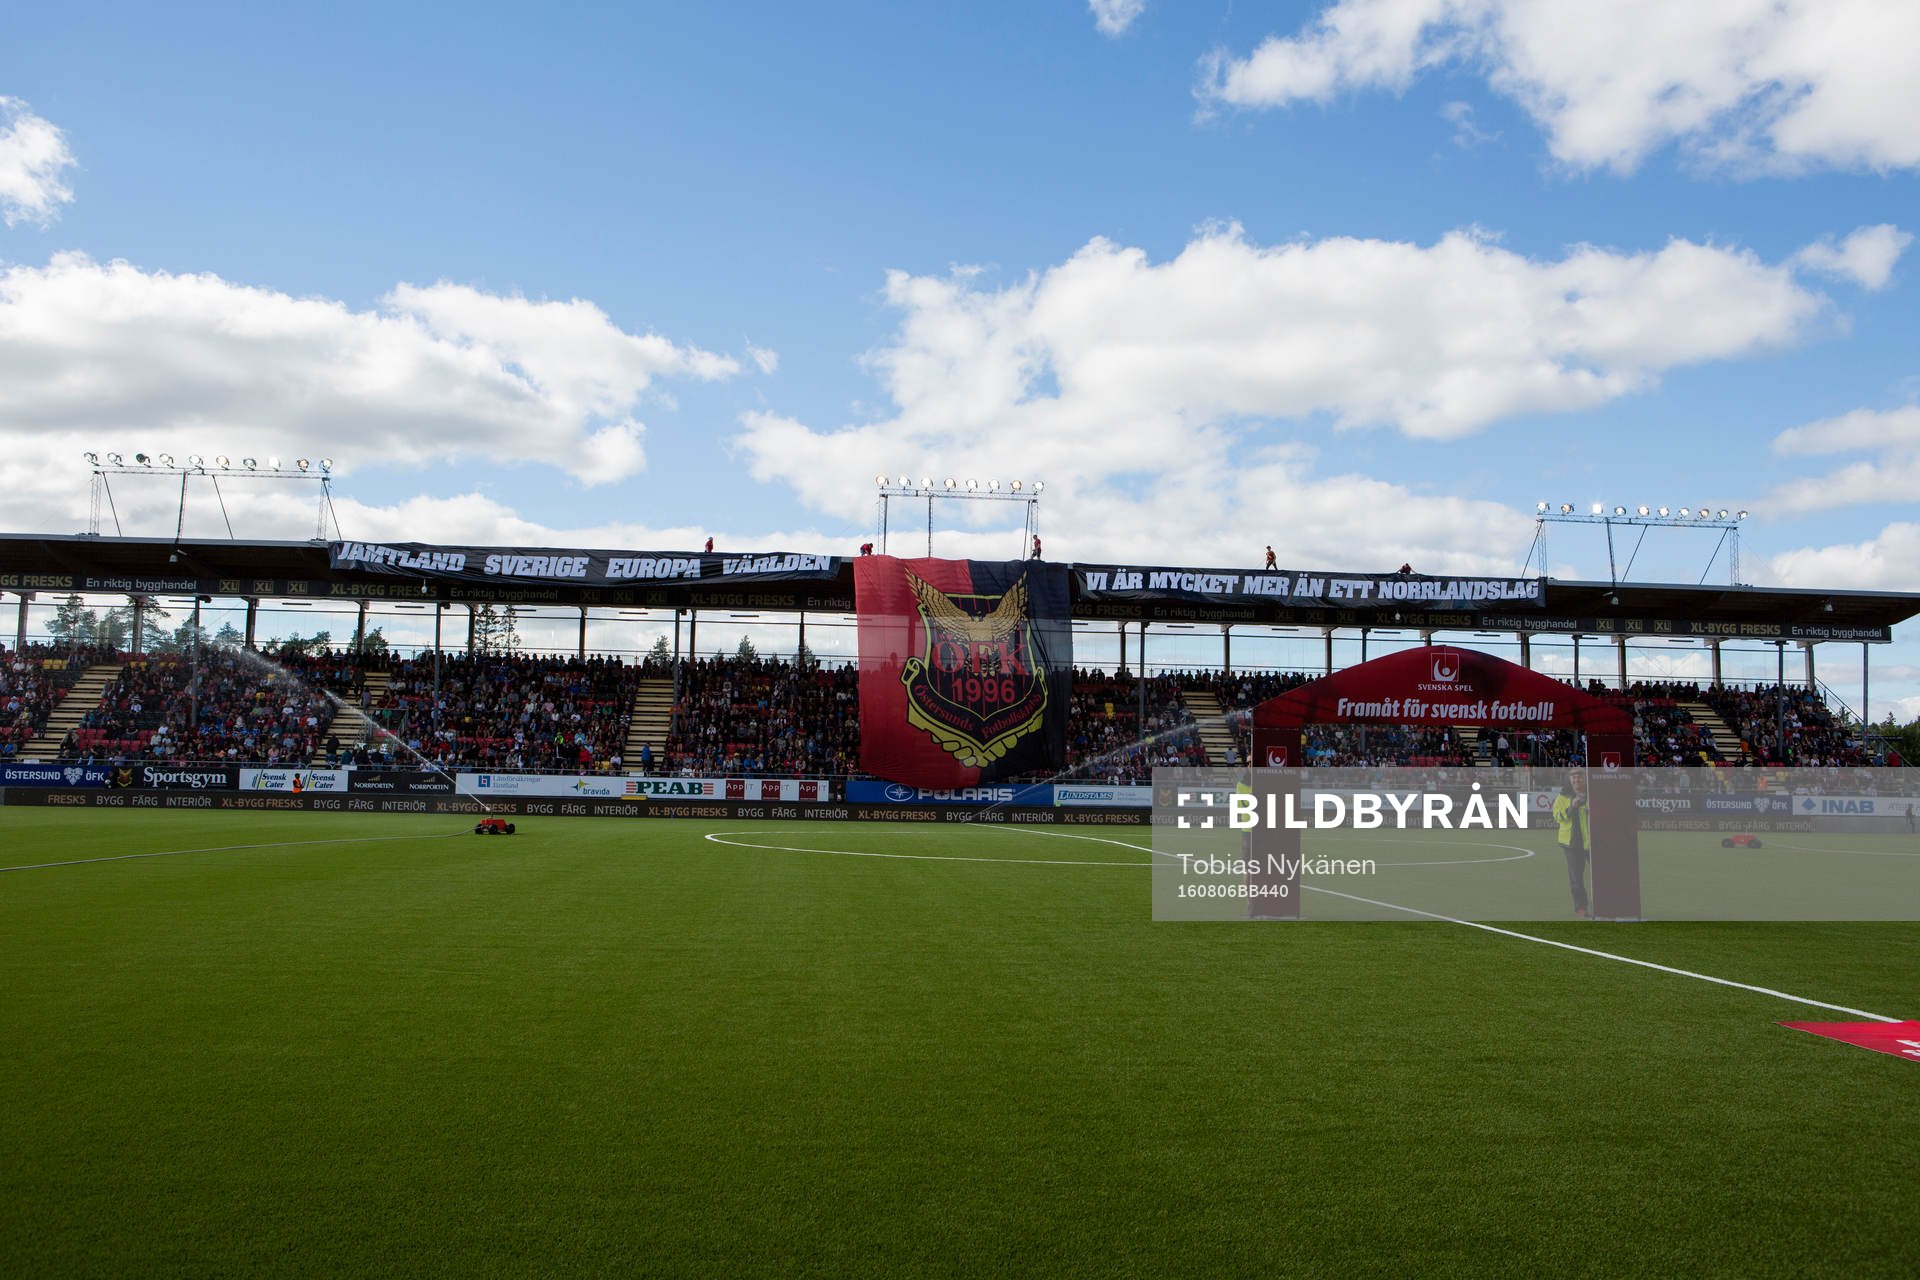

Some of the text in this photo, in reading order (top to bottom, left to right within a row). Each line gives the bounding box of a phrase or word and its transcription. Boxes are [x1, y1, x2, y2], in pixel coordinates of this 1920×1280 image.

[483, 554, 591, 577] SVERIGE
[605, 557, 701, 579] EUROPA
[722, 554, 832, 575] VÄRLDEN
[23, 575, 73, 587] FRESKS
[86, 577, 197, 591] En riktig bygghandel
[1086, 568, 1539, 600] VI ÄR MYCKET MER ÄN ETT NORRLANDSLAG
[330, 583, 438, 597] XL-BYGG FRESS
[451, 587, 558, 601] En riktig bygghandel
[750, 595, 796, 606] FRESKS
[807, 597, 851, 609] En riktig
[1096, 605, 1143, 617] FRESKS
[1154, 607, 1255, 620] En riktig bygghandel
[1428, 614, 1472, 626] FRESKS
[1482, 616, 1577, 630] En riktig bygghandel
[1690, 622, 1781, 635] XL-BYGG FRESKS
[1791, 626, 1882, 639] En riktig bygghandel
[932, 634, 1031, 676] ÖFK
[952, 678, 1016, 703] 1996
[1417, 683, 1473, 692] SVENSKA SPEL
[1337, 697, 1555, 721] Framåt för svensk fotboll!
[5, 769, 105, 781] ÖSTERSUND ÖFK
[143, 766, 228, 788] Sportsgym
[262, 772, 288, 781] Svensk
[310, 773, 336, 782] Svensk
[265, 780, 285, 789] Cater
[314, 781, 334, 789] Cater
[582, 787, 610, 795] bravida
[635, 781, 704, 795] PEAB
[918, 787, 1014, 801] POLARIS
[48, 794, 87, 804] FRESKS
[96, 795, 124, 805] BYGG
[132, 793, 158, 805] FÄRG
[166, 795, 212, 807] INTERIÖR
[222, 797, 265, 808] XL-BYGG
[266, 797, 304, 809] FRESKS
[314, 799, 341, 809] BYGG
[348, 798, 374, 810] FÄRG
[382, 799, 427, 811] INTERIÖR
[437, 802, 478, 812] XL-BYGG
[527, 803, 553, 814] BYGG
[561, 803, 587, 815] FÄRG
[594, 803, 639, 815] INTERIÖR
[648, 806, 690, 817] XL-BYGG
[691, 807, 728, 817] FRESKS
[737, 808, 764, 818] BYGG
[771, 807, 798, 818] FÄRG
[805, 807, 849, 819] INTERIÖR
[858, 810, 899, 820] XL-BYGG
[900, 810, 937, 820] FRESKS
[946, 811, 973, 822] BYGG
[979, 810, 1005, 822] FÄRG
[1011, 810, 1055, 823] INTERIÖR
[1064, 812, 1105, 823] XL-BYGG
[1105, 813, 1141, 824] FRESKS
[1150, 814, 1174, 825] BYGG
[1635, 797, 1691, 812] ortsgym
[1706, 798, 1788, 810] ÖSTERSUND ÖFK
[1821, 800, 1875, 813] INAB
[1640, 820, 1677, 830] XL-BYGG
[1678, 821, 1711, 830] FRESKS
[1719, 821, 1741, 830] BYGG
[1747, 820, 1770, 830] FÄRG
